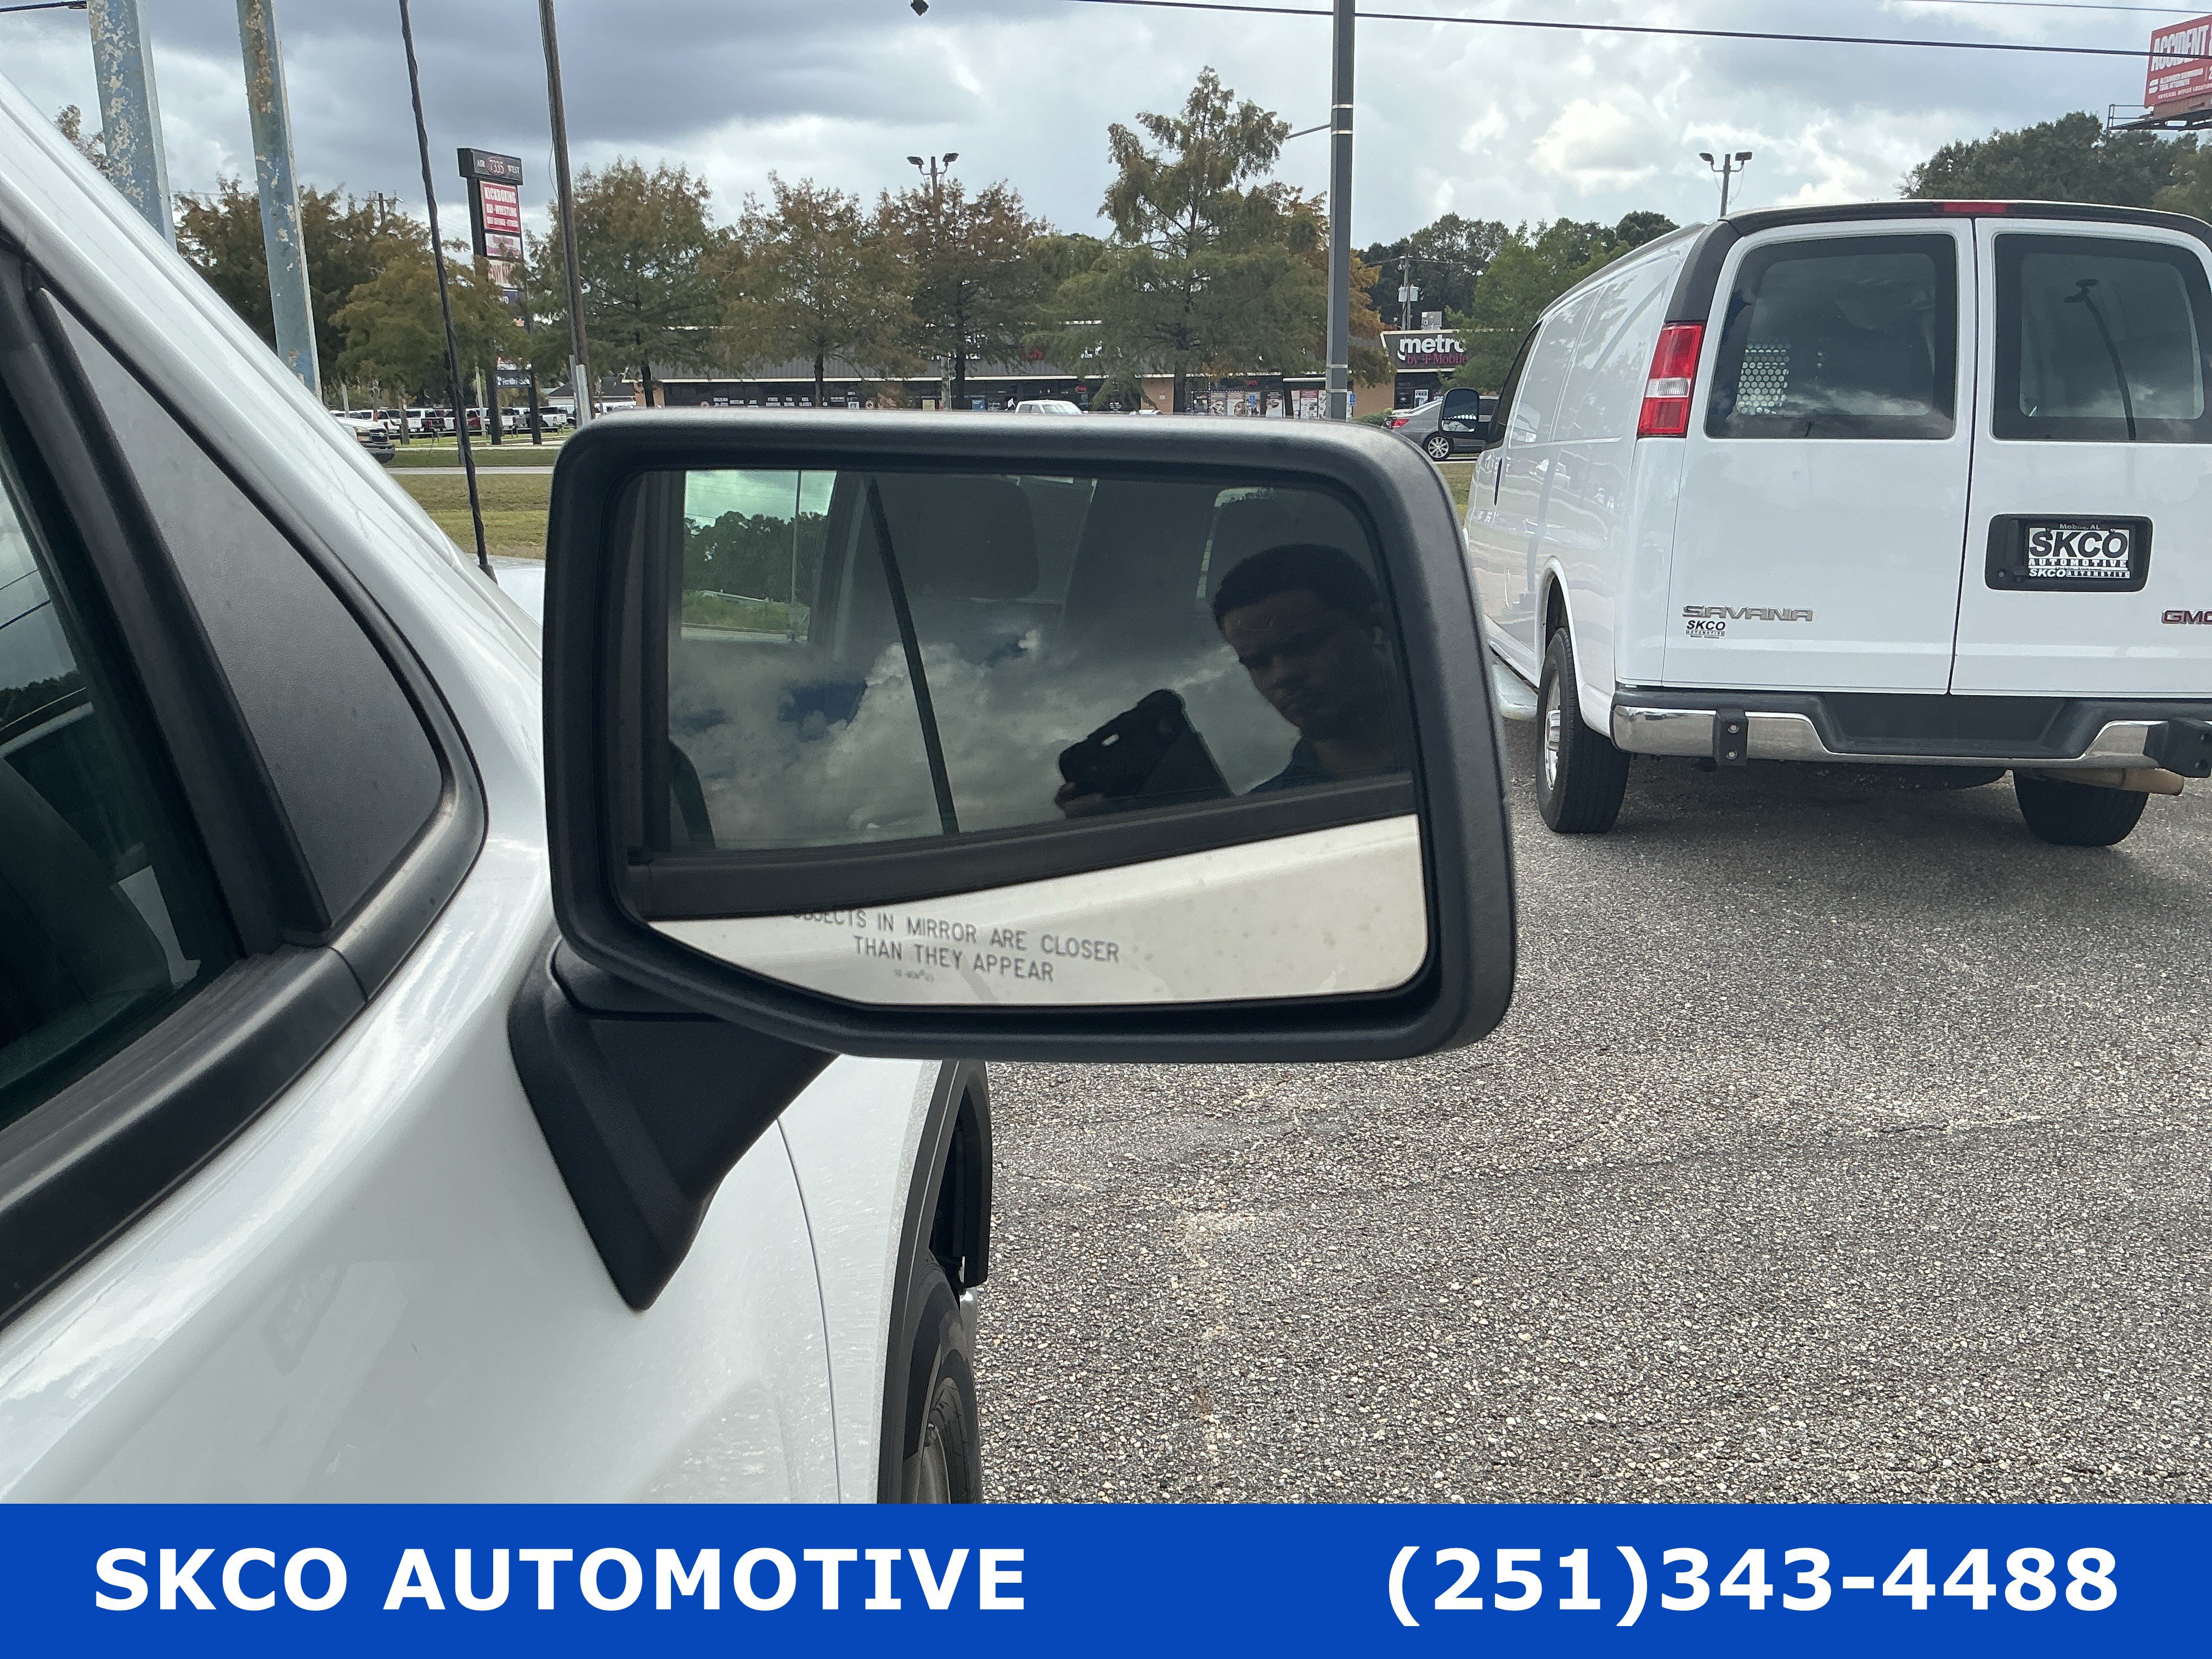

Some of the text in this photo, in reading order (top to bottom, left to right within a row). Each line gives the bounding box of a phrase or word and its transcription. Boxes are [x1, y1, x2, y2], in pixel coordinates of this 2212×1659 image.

[2151, 25, 2209, 72] ACCIDENT
[489, 159, 504, 174] 7335
[507, 165, 520, 174] WEST
[484, 187, 516, 204] KICKBOXING
[1397, 334, 1468, 361] metro
[1407, 353, 1419, 365] by
[2029, 531, 2129, 558] SKCO
[2028, 558, 2128, 567] AUTOMOTIVE
[2029, 569, 2066, 577] SKCO
[1682, 604, 1814, 622] SAVANA
[1686, 620, 1726, 631] SKCO
[877, 913, 895, 932] IN
[906, 916, 977, 944] MIRROR
[989, 928, 1028, 951] ARE
[1041, 933, 1120, 963] CLOSER
[853, 935, 1054, 983] THAN THEY APPEAR
